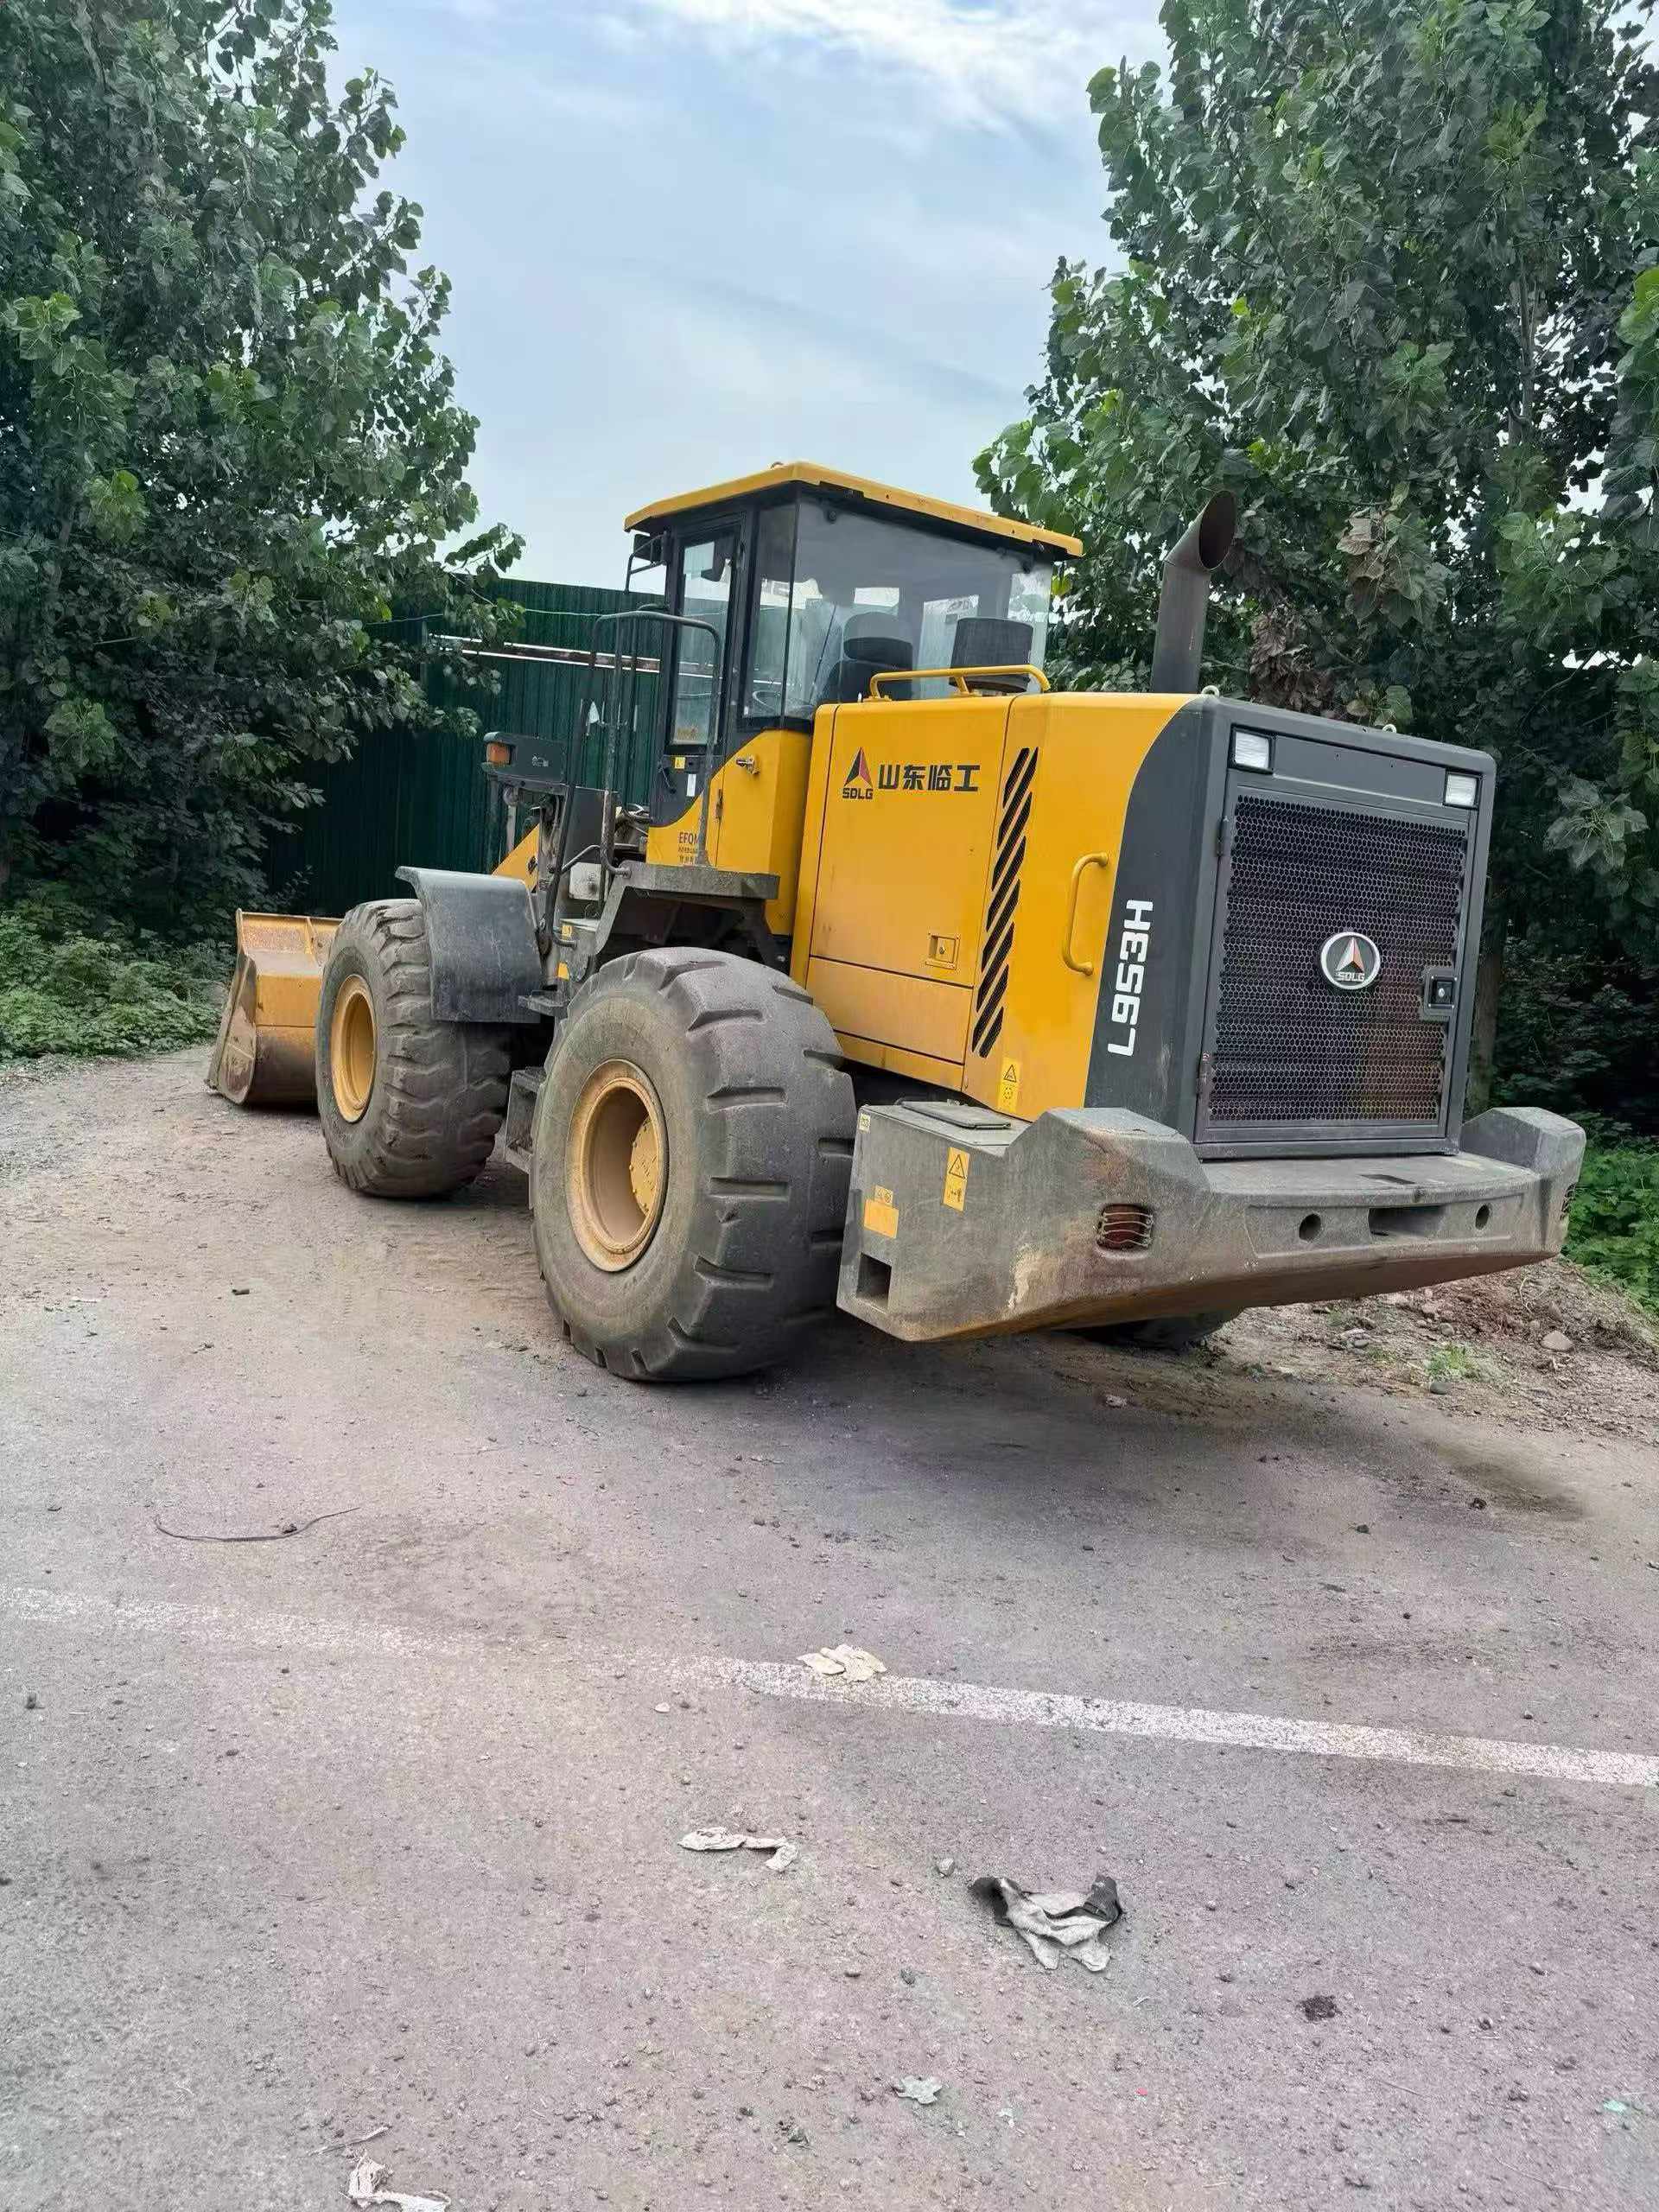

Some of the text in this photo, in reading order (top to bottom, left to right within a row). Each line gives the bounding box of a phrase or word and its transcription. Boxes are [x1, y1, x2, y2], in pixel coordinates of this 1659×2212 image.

[878, 764, 980, 791] 山东临工
[842, 787, 873, 799] SDLG
[1107, 899, 1154, 1056] L953H
[1335, 972, 1365, 982] SDLG
